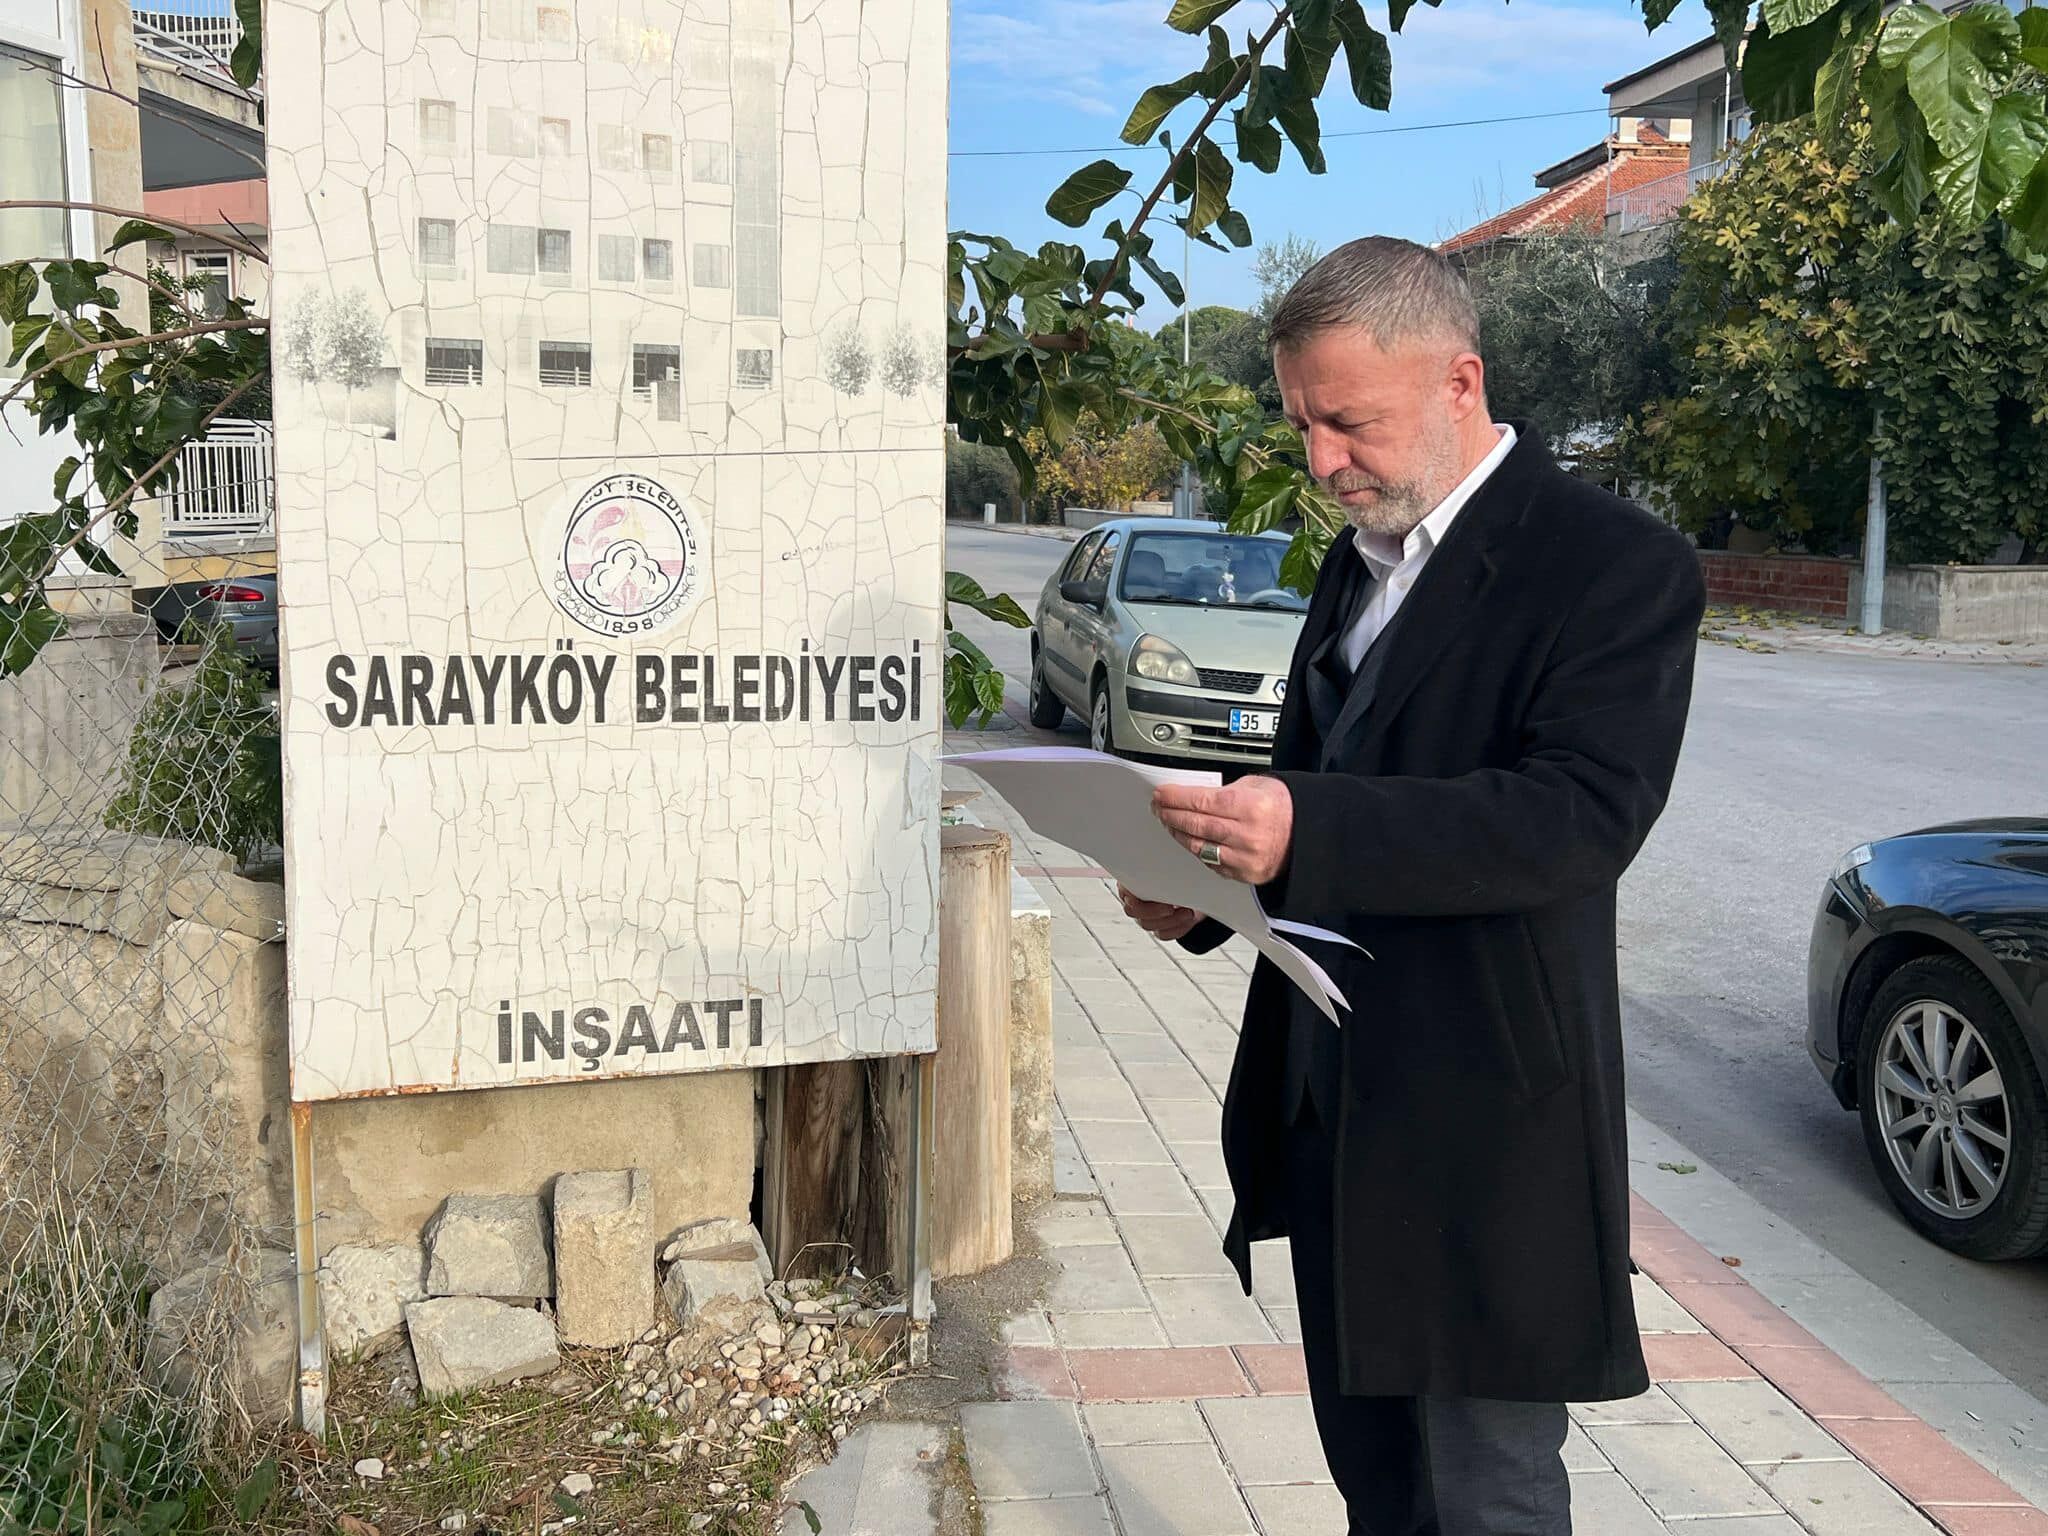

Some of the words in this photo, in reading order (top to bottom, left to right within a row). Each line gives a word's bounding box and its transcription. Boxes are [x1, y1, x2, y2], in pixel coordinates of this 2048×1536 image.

[604, 617, 653, 634] 1898
[325, 639, 616, 727] SARAYKÖY
[636, 638, 921, 724] BELEDİYESİ
[1241, 713, 1259, 731] 35
[498, 998, 763, 1071] İNŞAATI
